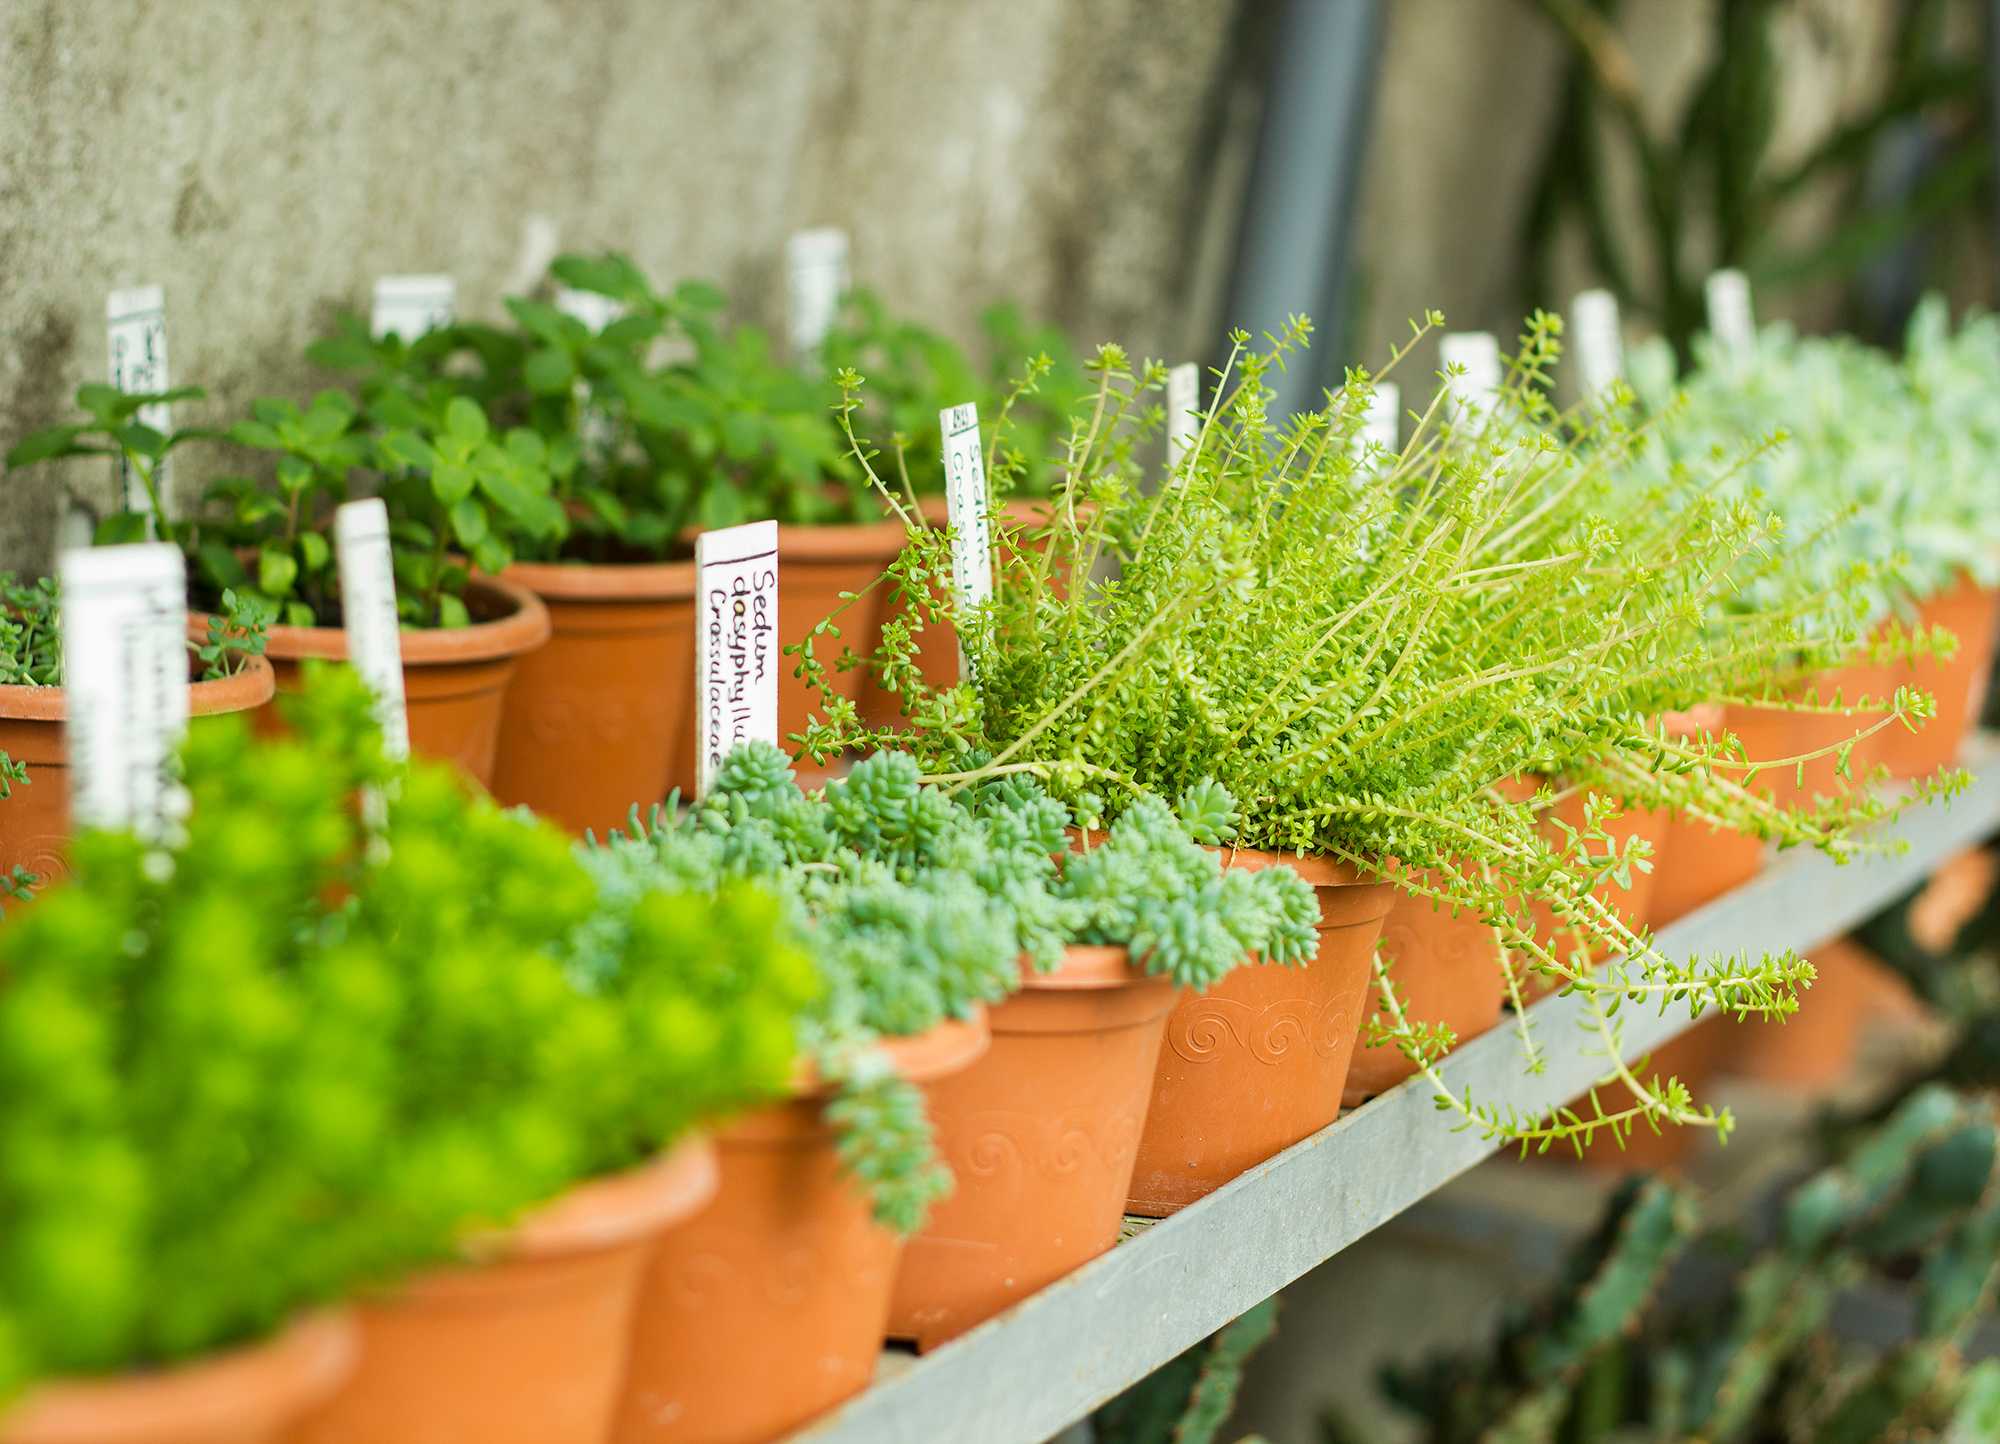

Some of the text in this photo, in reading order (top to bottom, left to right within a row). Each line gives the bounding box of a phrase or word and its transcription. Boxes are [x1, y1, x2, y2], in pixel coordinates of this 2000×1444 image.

[708, 588, 727, 769] Crassulaceae
[727, 575, 751, 742] dasyphyllu
[752, 569, 775, 686] Sedum
